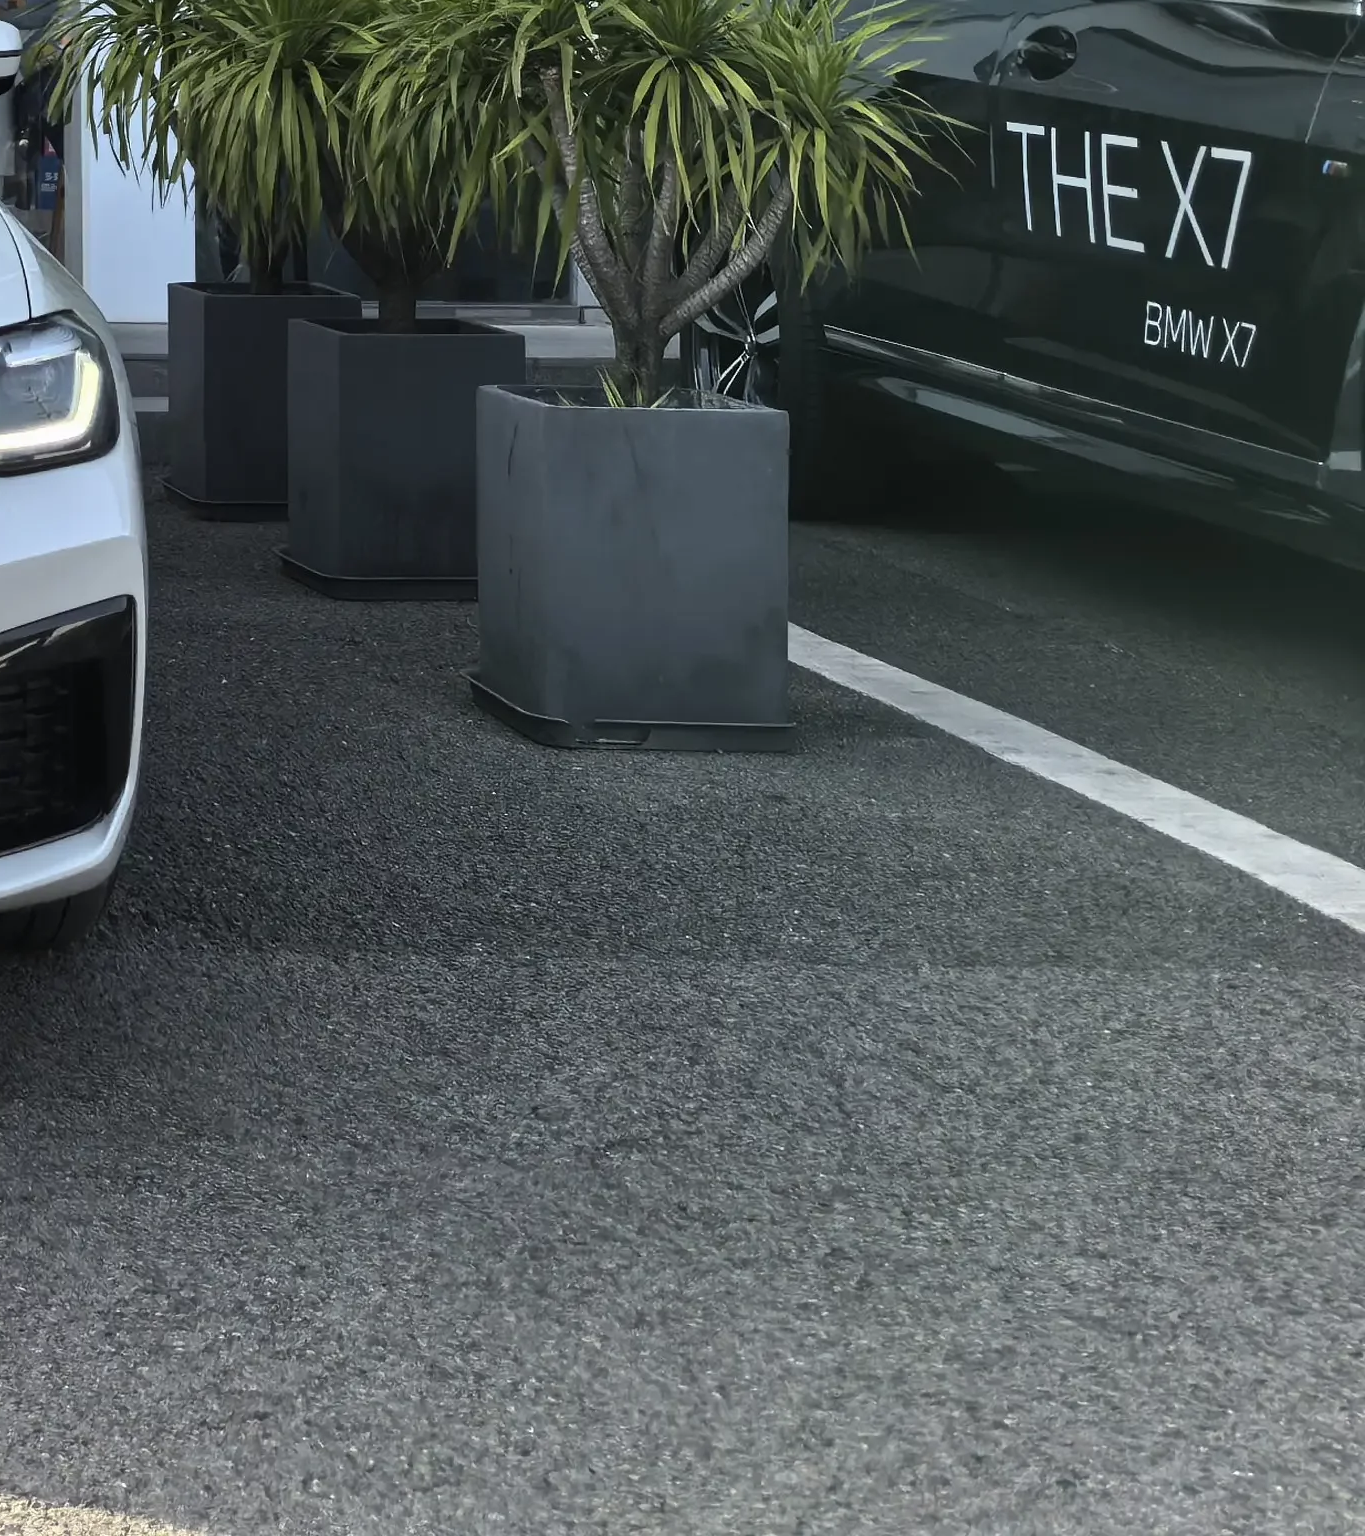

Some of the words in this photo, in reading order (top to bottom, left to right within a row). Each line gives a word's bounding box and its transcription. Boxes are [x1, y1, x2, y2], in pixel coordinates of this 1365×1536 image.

[1006, 121, 1145, 254] THE
[1160, 140, 1252, 270] X7
[1144, 301, 1216, 360] BMW
[1218, 317, 1257, 368] X7
